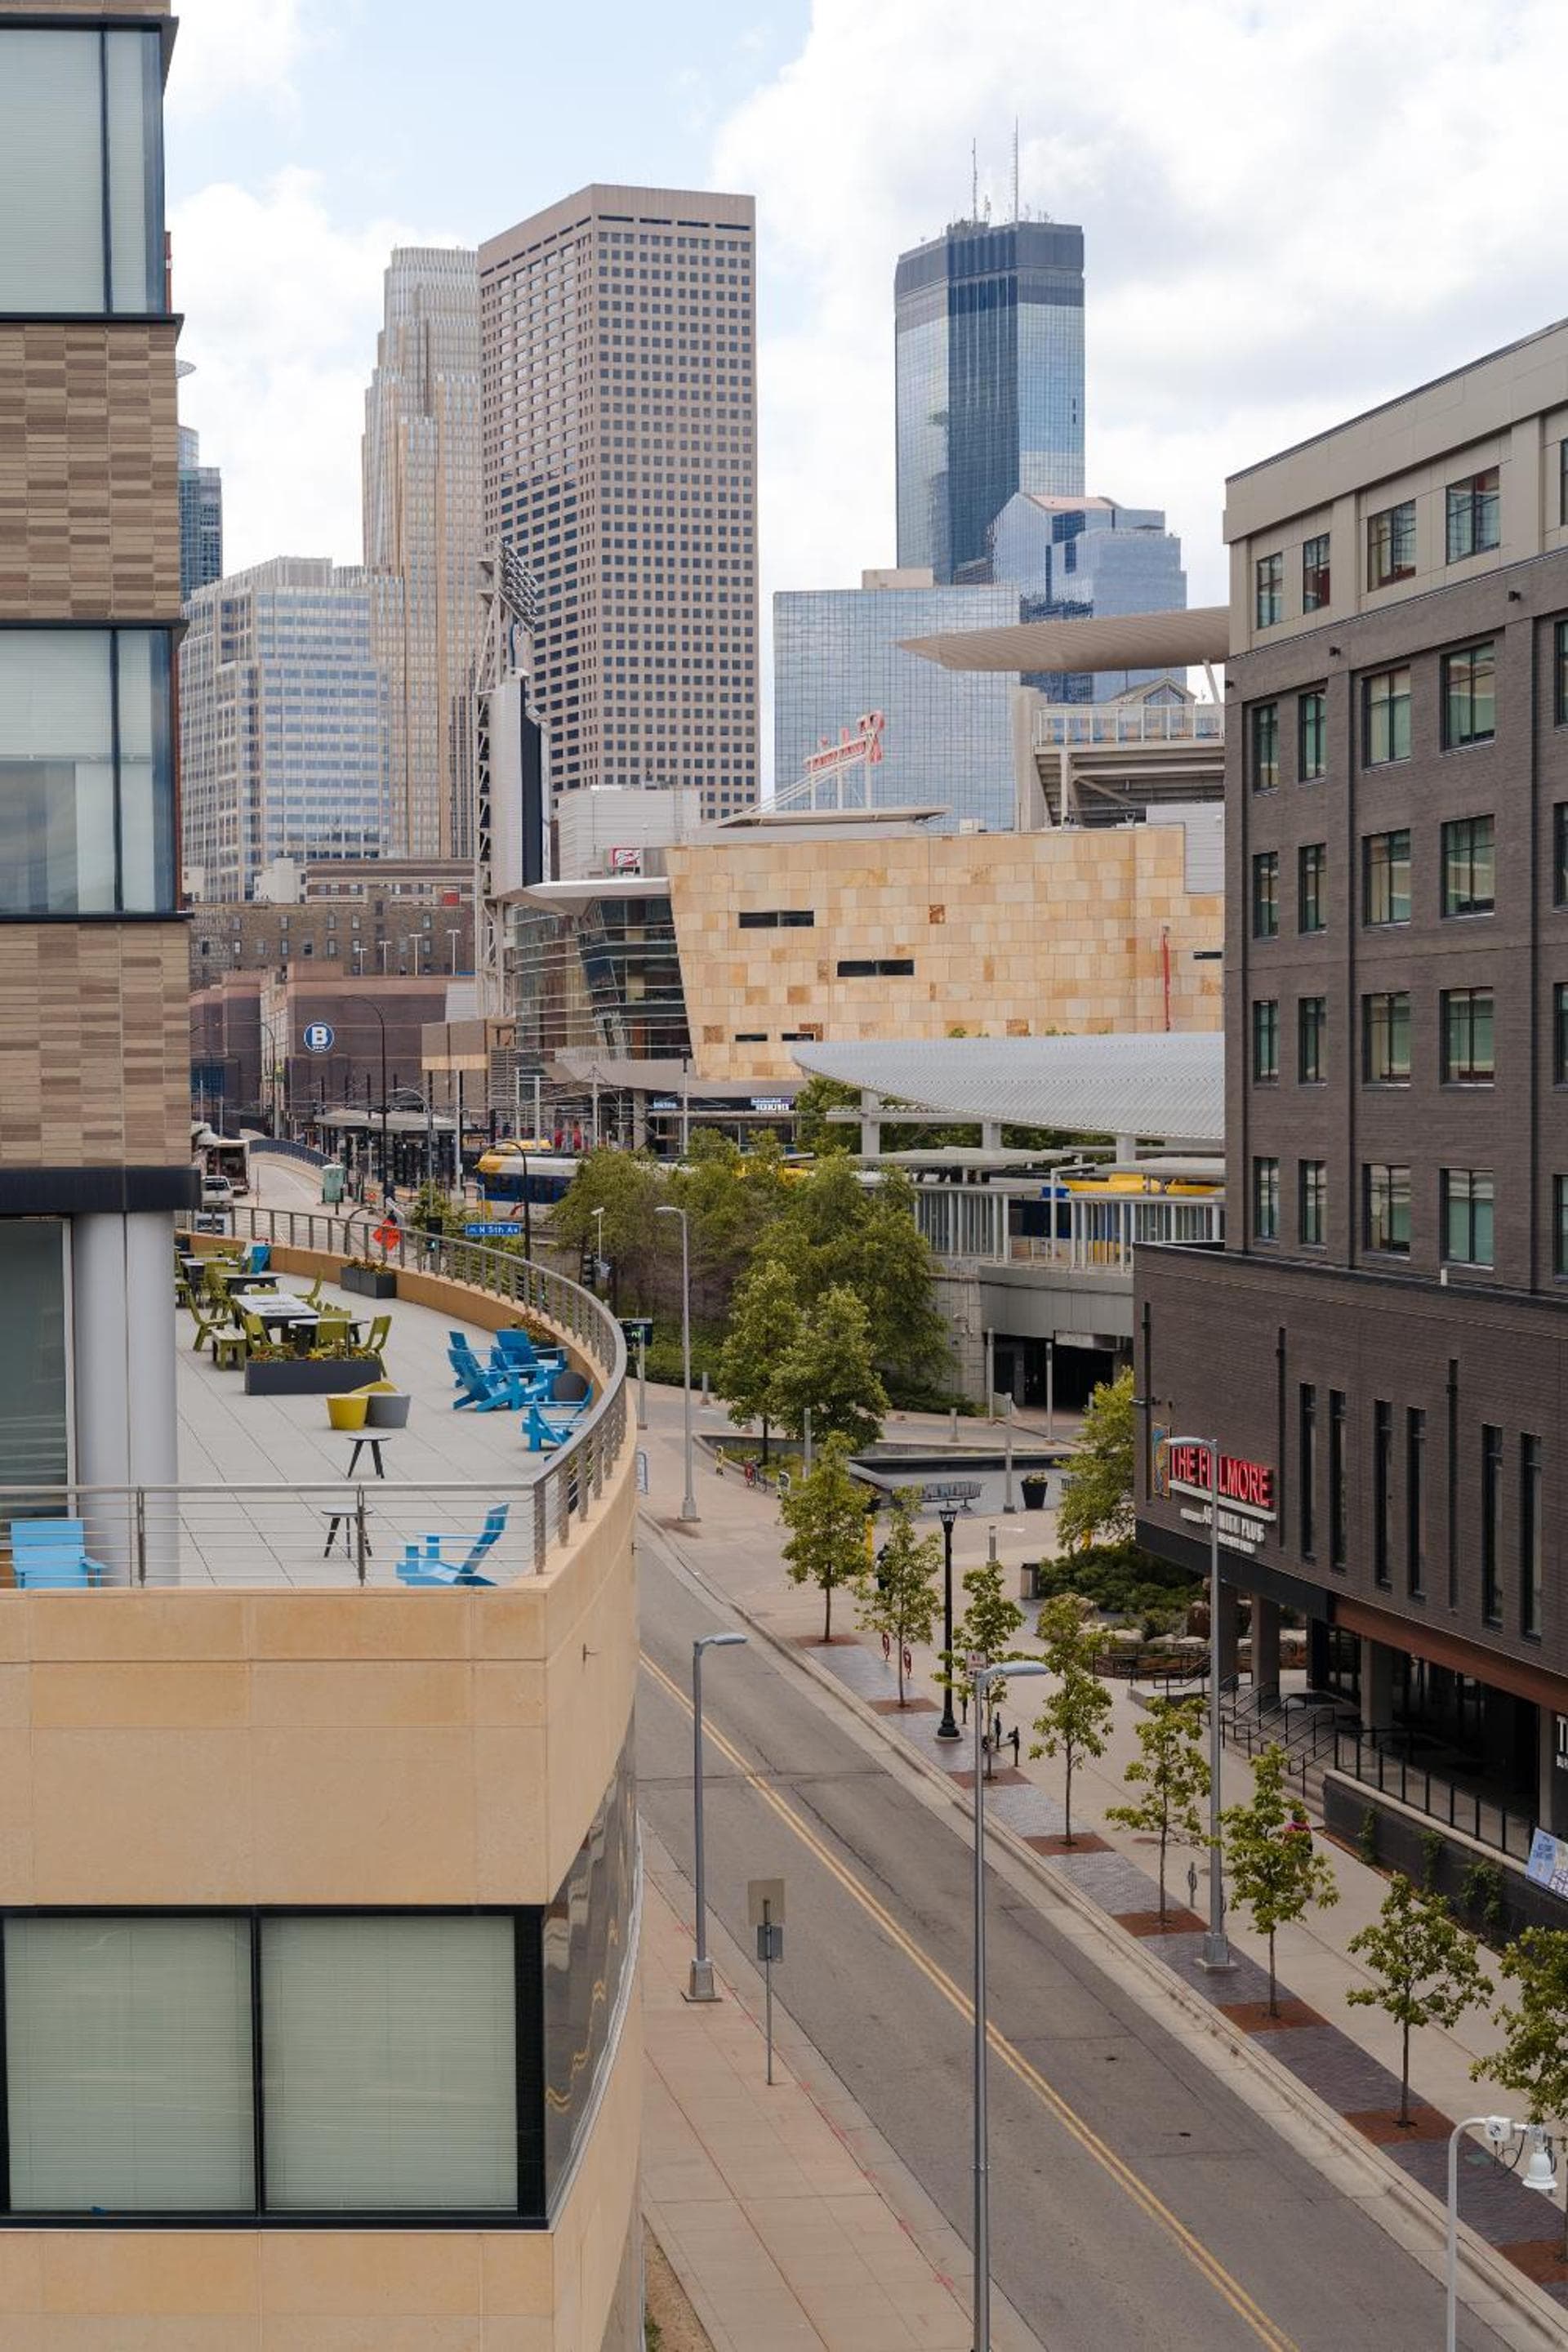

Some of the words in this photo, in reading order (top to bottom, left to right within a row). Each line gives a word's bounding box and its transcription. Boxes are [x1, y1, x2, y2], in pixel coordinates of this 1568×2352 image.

[312, 1027, 327, 1045] B
[1171, 1446, 1196, 1484] THE
[1198, 1447, 1273, 1508] FILMORE
